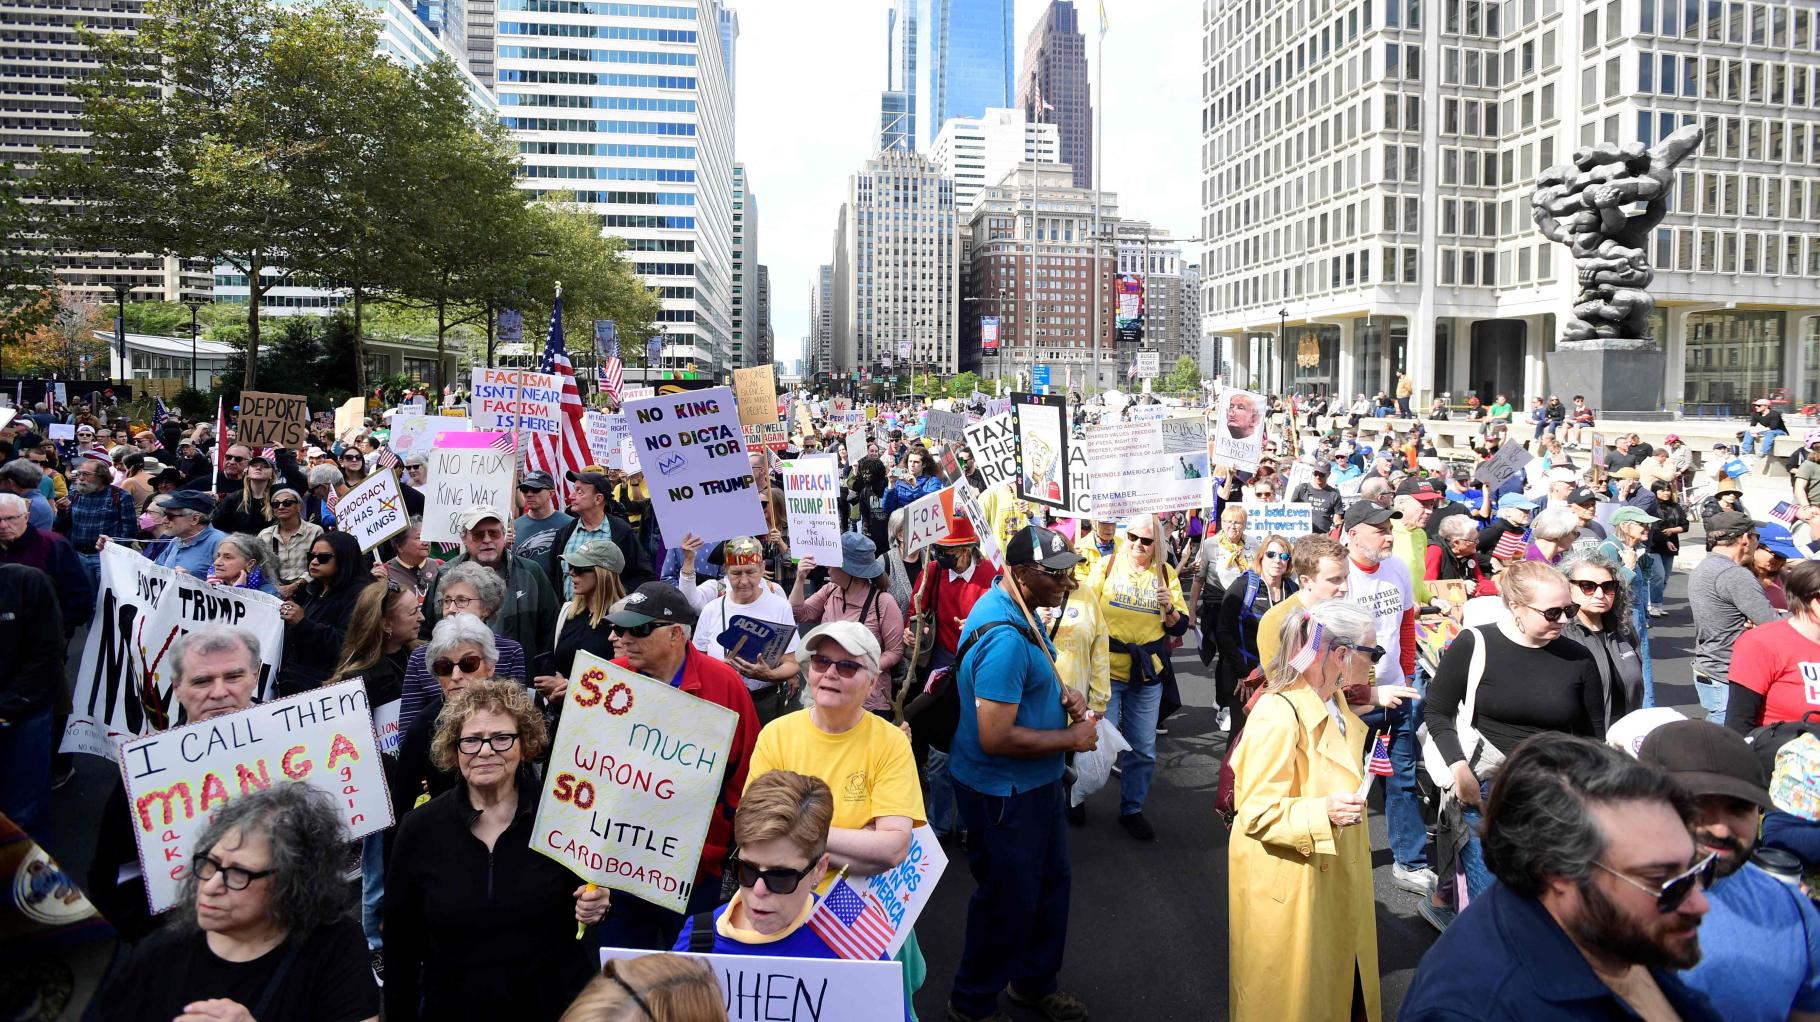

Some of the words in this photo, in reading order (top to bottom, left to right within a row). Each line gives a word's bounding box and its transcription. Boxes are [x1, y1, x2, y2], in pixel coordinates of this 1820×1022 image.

[475, 385, 517, 399] ISN'T
[522, 387, 560, 403] NEAR
[242, 397, 306, 422] DEPORT
[637, 407, 664, 424] NO
[674, 400, 720, 419] KING
[239, 420, 302, 445] NAZIS
[497, 415, 515, 427] IS
[519, 416, 560, 433] HERE!
[756, 423, 784, 433] OWELL
[968, 417, 1013, 446] TAX
[645, 433, 672, 451] NO
[764, 432, 784, 442] AGAIN
[1221, 437, 1256, 451] FASCIST
[704, 439, 741, 459] TOR
[979, 437, 1016, 462] THE
[1230, 448, 1244, 458] PIG
[438, 453, 461, 474] NO
[470, 454, 506, 475] FAUX
[981, 456, 1016, 486] RIC
[1122, 467, 1156, 476] AMERICA'S
[1156, 465, 1174, 473] LIGHT
[436, 480, 463, 505] KING
[470, 482, 498, 505] WAY
[668, 485, 694, 502] NO
[699, 474, 755, 496] TRUMP
[786, 473, 832, 491] IMPEACH
[336, 480, 387, 525] DEMOCRACY
[788, 498, 823, 515] TRUMP
[1287, 508, 1310, 518] even
[354, 506, 374, 526] HAS
[365, 511, 397, 537] KINGS
[809, 516, 836, 529] ignoring
[912, 504, 939, 526] FOR
[1254, 519, 1310, 531] introverts
[806, 528, 818, 536] the
[909, 524, 946, 548] ALL
[178, 586, 247, 625] TRUMP
[1115, 593, 1131, 604] SEEK
[1368, 588, 1400, 601] RATHER
[1383, 597, 1401, 606] THE
[734, 617, 770, 638] ACLU
[573, 666, 635, 717] SO
[128, 741, 167, 779] I
[181, 717, 264, 763] CALL
[272, 689, 368, 732] THEM
[628, 722, 717, 774] MUCH
[135, 733, 361, 833] MANGA
[573, 744, 676, 800] WRONG
[552, 773, 596, 810] SO
[589, 811, 679, 858] LITTLE
[888, 869, 902, 892] IN
[897, 859, 921, 893] NGS
[725, 967, 829, 1022] HEN
